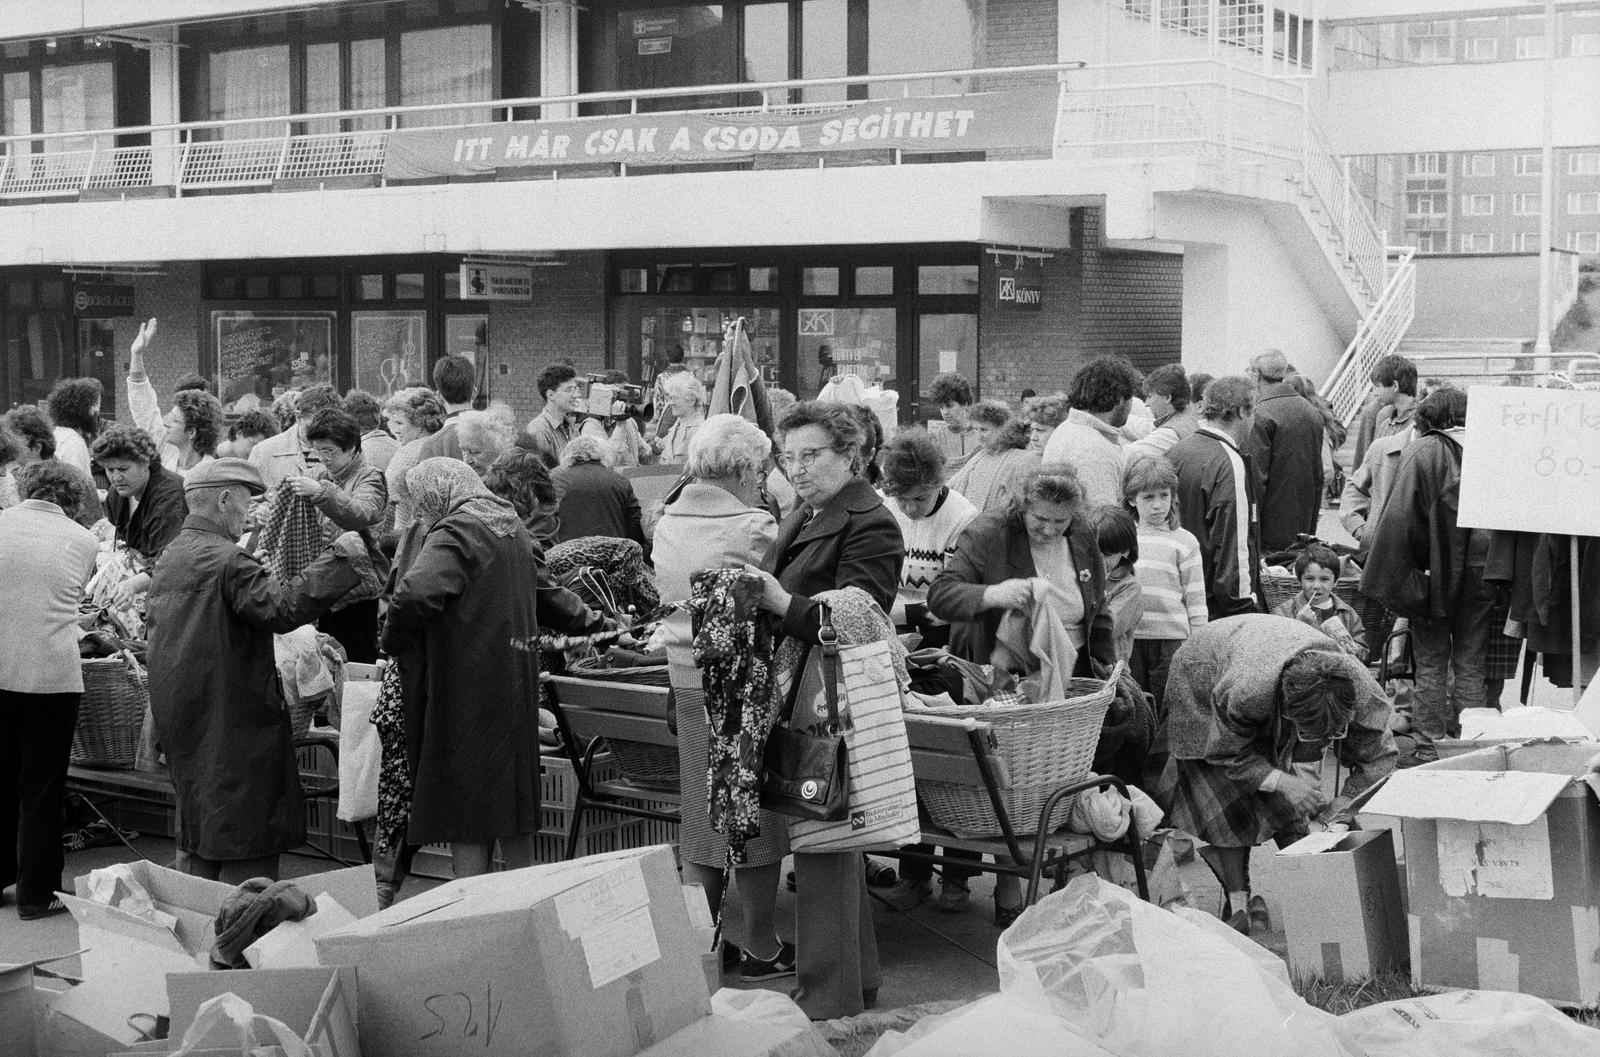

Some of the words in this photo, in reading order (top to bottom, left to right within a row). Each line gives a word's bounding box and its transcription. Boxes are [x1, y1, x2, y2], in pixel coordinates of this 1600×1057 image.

[453, 136, 493, 162] ITT
[504, 129, 571, 159] MÁR
[584, 127, 659, 155] CSAK
[668, 126, 691, 151] A
[702, 125, 801, 151] CSODA
[818, 106, 975, 147] SEGÍTHET
